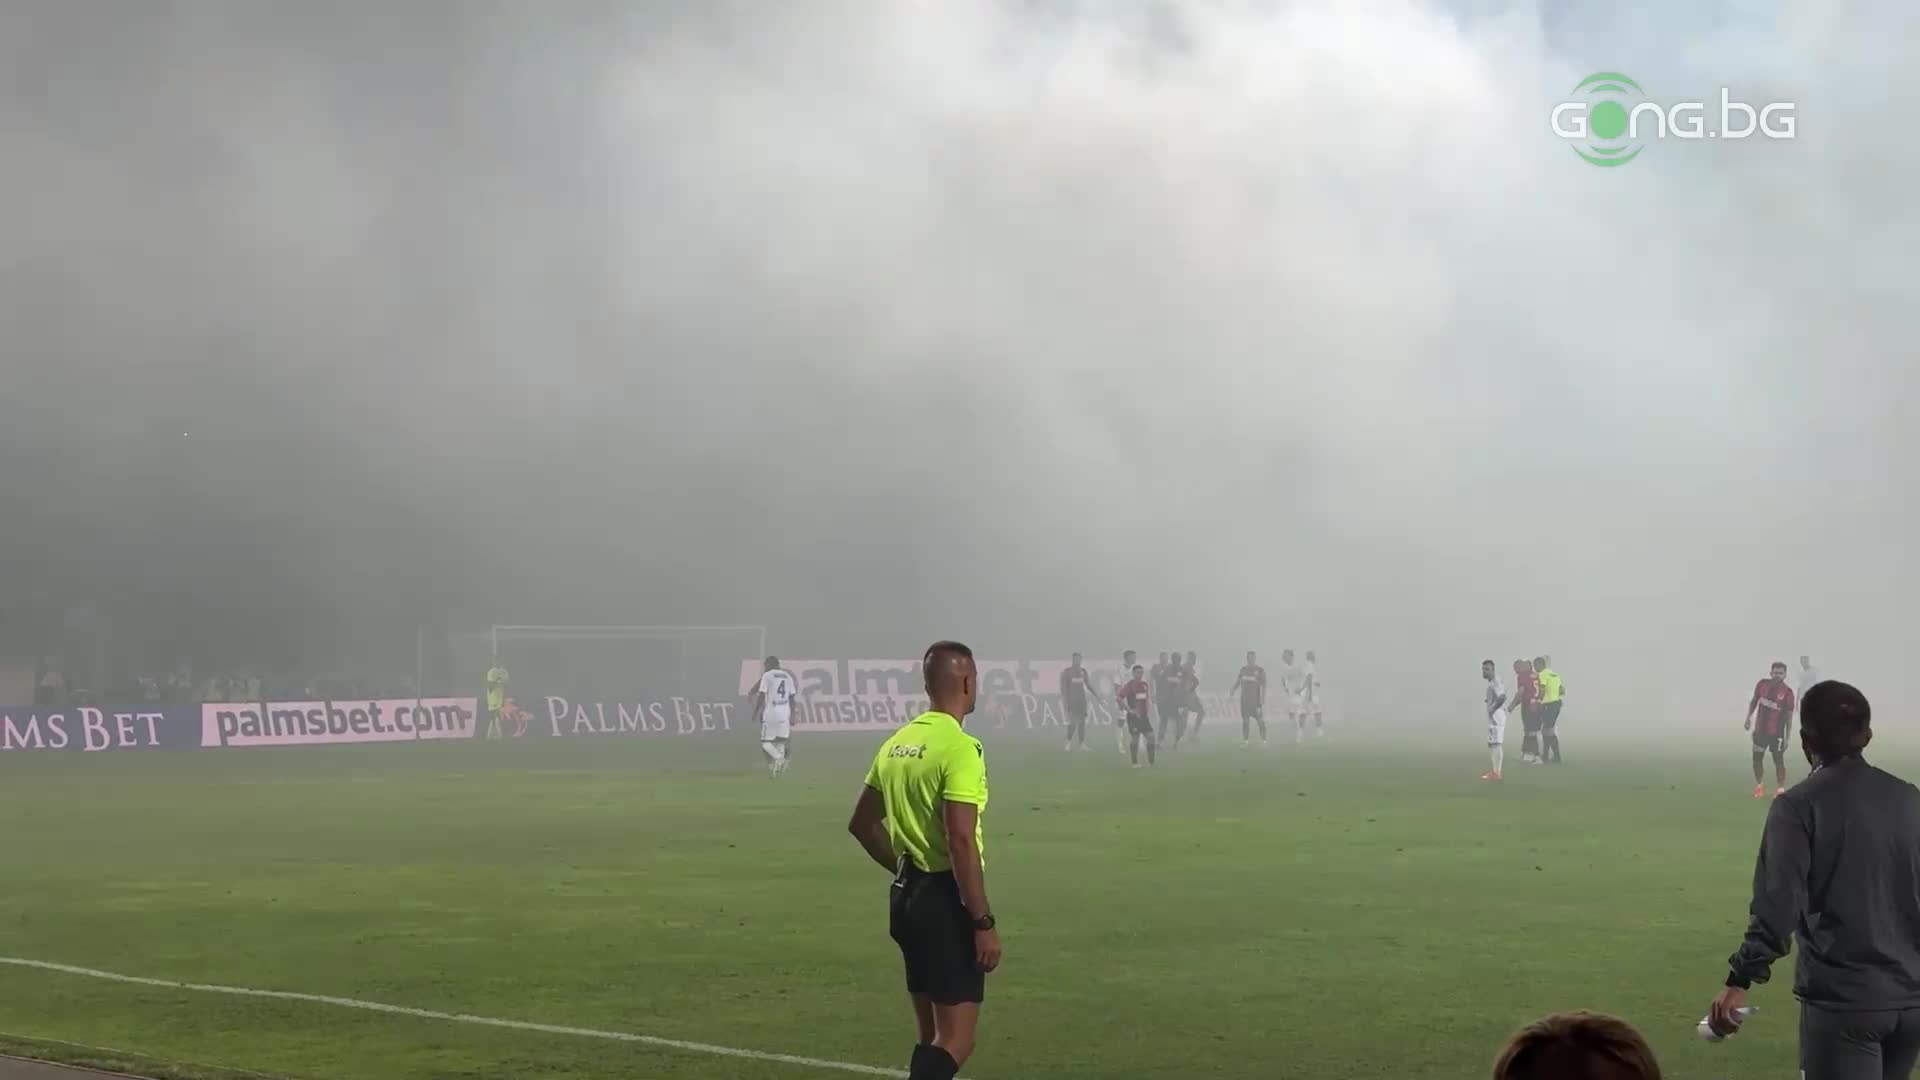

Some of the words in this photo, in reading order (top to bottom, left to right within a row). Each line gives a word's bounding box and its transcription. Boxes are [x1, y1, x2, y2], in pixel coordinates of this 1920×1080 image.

[777, 680, 786, 698] 4
[76, 707, 164, 751] BET
[216, 701, 465, 746] palmsbet.com
[544, 696, 666, 736] PALMS
[670, 696, 734, 734] BET
